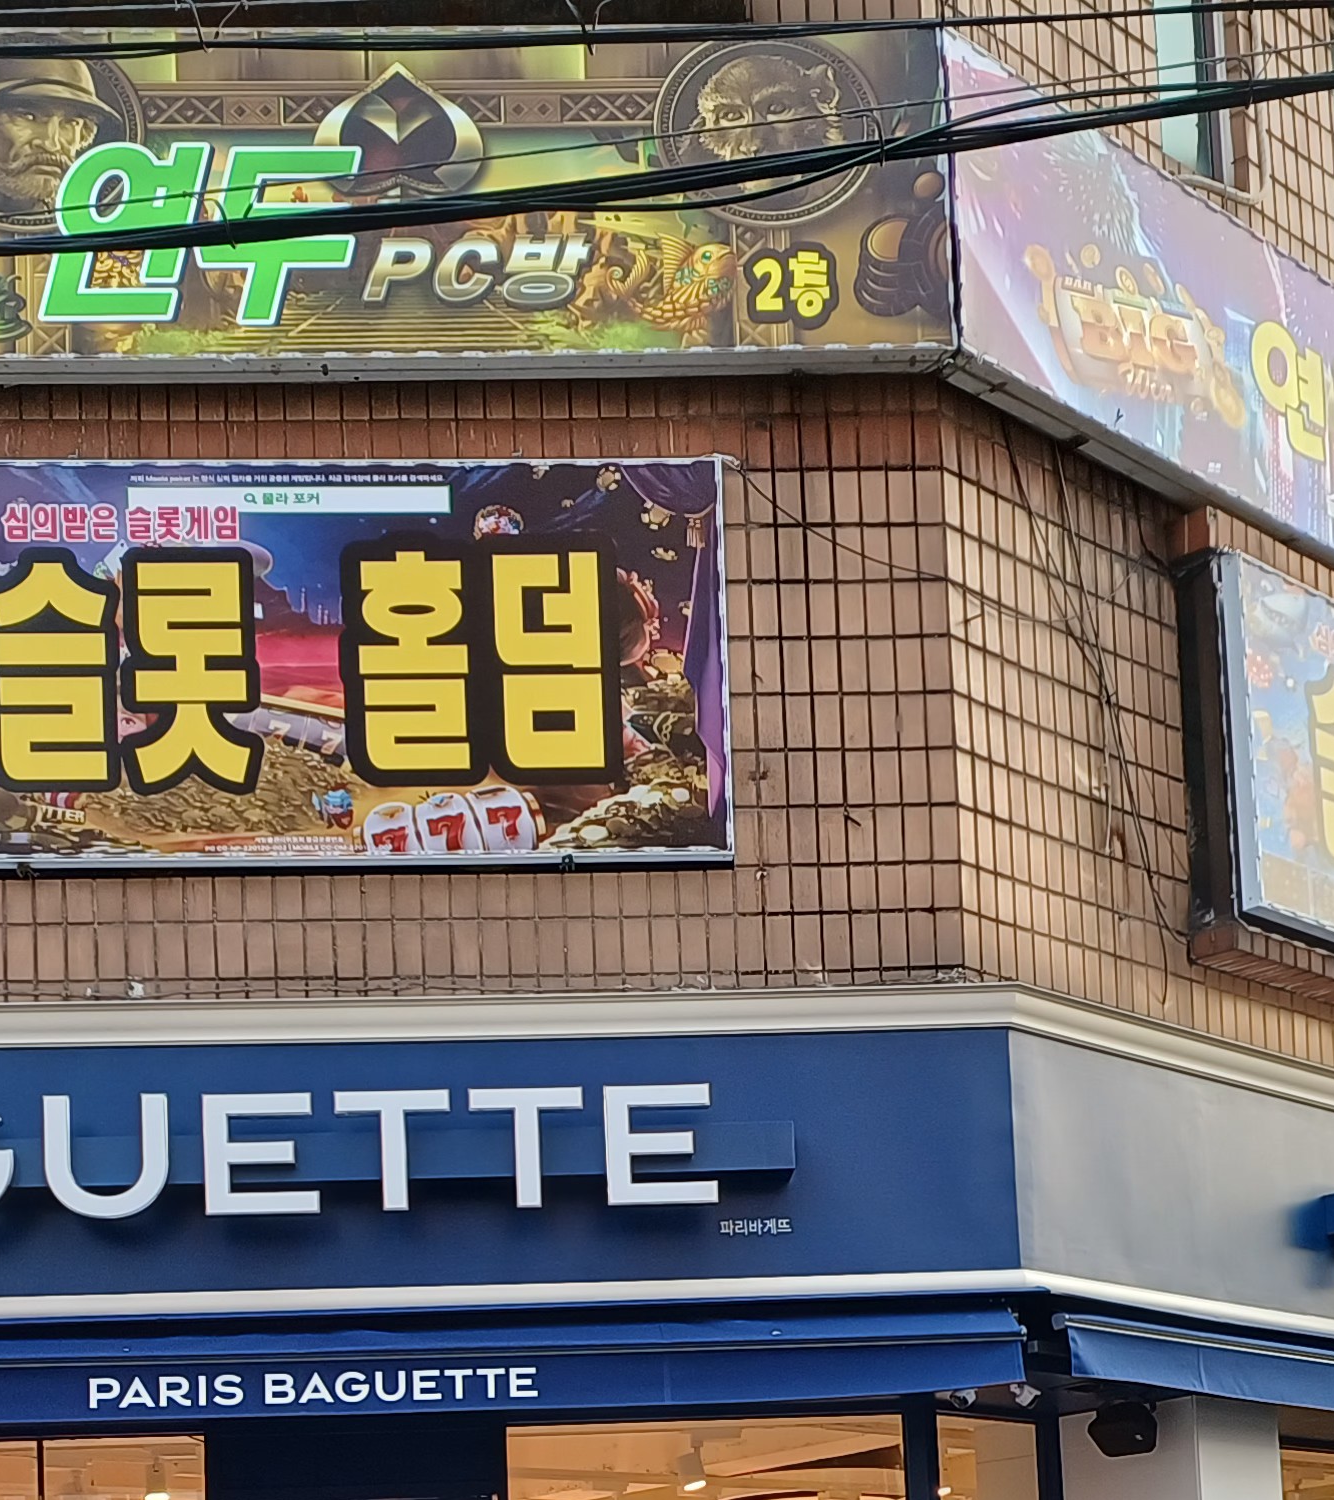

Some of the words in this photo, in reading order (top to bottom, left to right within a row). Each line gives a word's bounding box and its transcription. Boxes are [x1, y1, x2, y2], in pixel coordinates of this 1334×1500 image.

[38, 141, 363, 325] 연두
[363, 232, 595, 308] PC방
[752, 251, 831, 318] 2층
[1071, 294, 1199, 376] BIG
[2, 504, 119, 543] 심의받은
[126, 504, 241, 543] 슬롯게임
[293, 492, 320, 506] 포커
[357, 550, 608, 771] 홀덤
[718, 1216, 793, 1237] 파리바게뜨
[87, 1373, 245, 1410] PARIS
[263, 1366, 540, 1404] BAGUETTE
